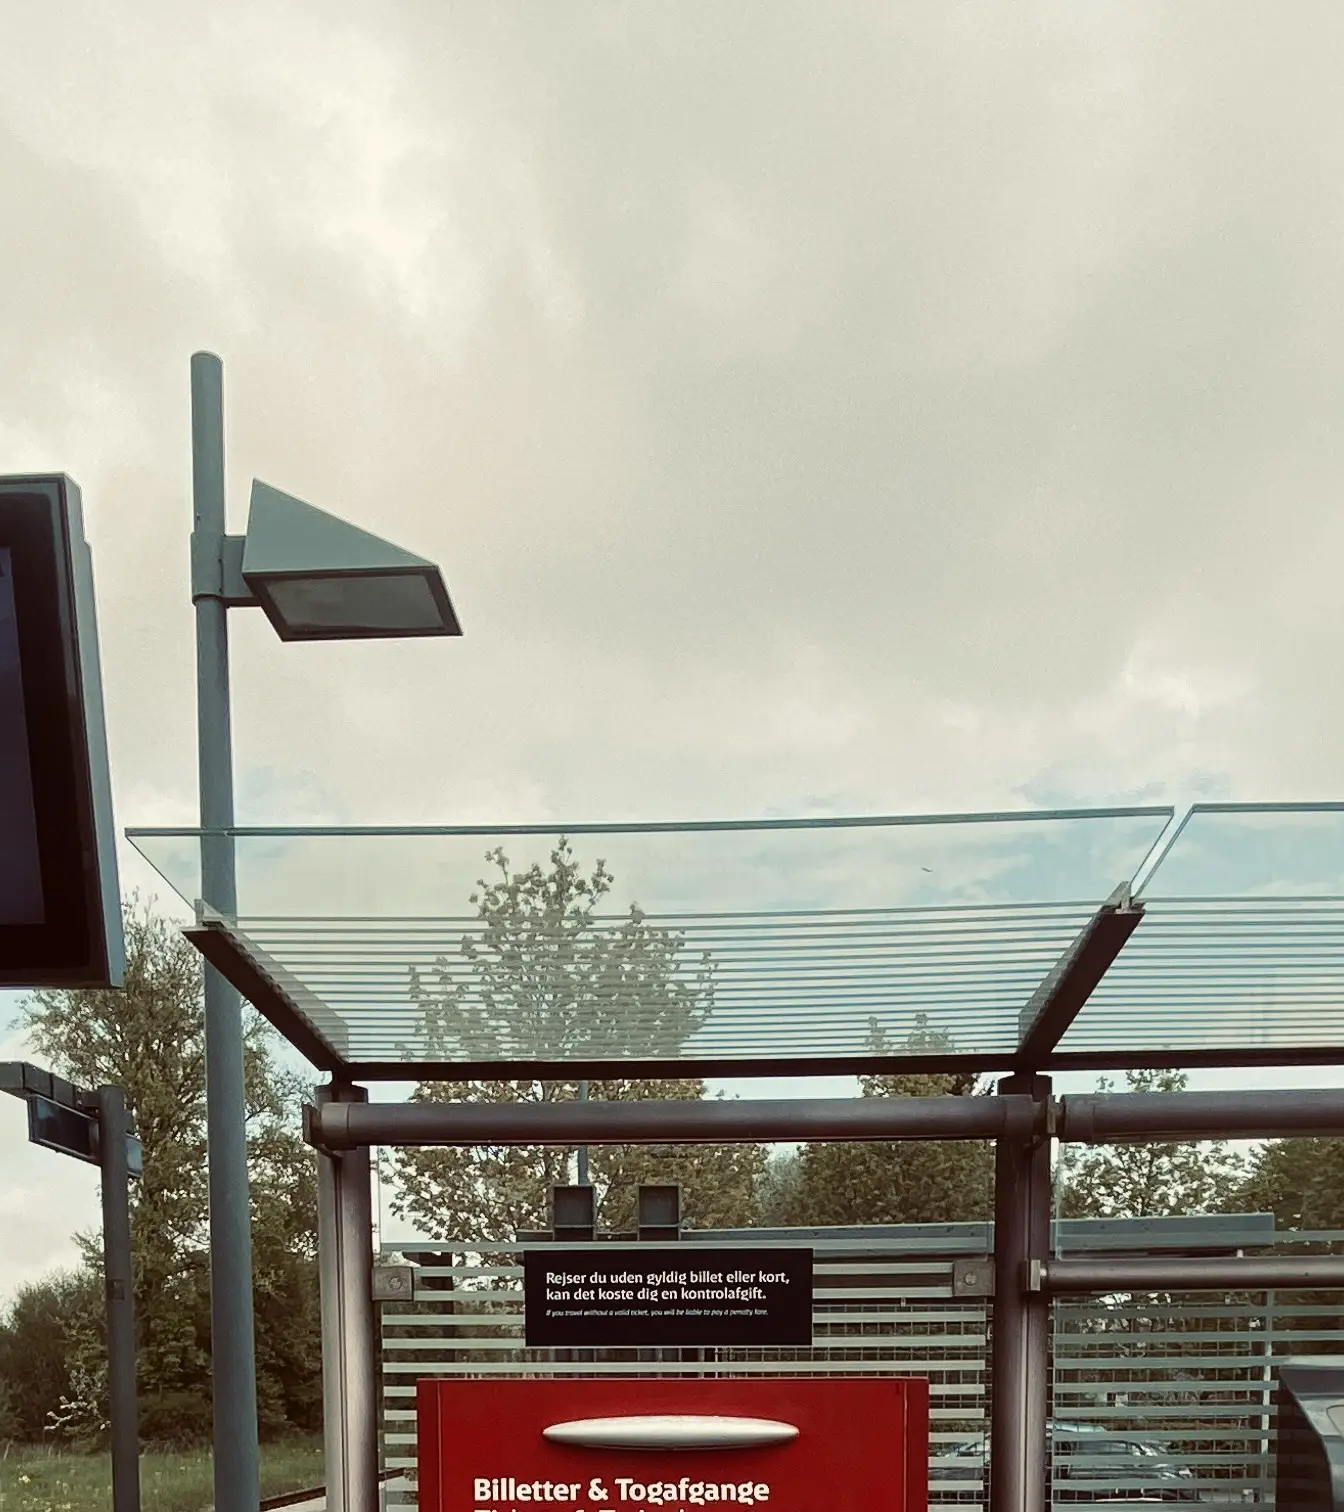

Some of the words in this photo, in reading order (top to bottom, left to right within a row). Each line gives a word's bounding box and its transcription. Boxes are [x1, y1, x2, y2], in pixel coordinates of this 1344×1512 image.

[546, 1272, 587, 1287] Rejser
[589, 1271, 607, 1284] du
[610, 1271, 643, 1284] uden
[646, 1270, 687, 1286] gyldig
[690, 1270, 723, 1284] billet
[726, 1270, 756, 1283] eller
[759, 1270, 790, 1285] kort,
[546, 1288, 571, 1301] kan
[573, 1287, 596, 1301] det
[598, 1287, 634, 1300] koste
[636, 1287, 659, 1302] dig
[661, 1290, 678, 1300] en
[681, 1286, 767, 1301] kontrolafgift.
[473, 1478, 582, 1502] Billetter
[587, 1478, 609, 1502] &
[614, 1478, 770, 1506] Togafgange
